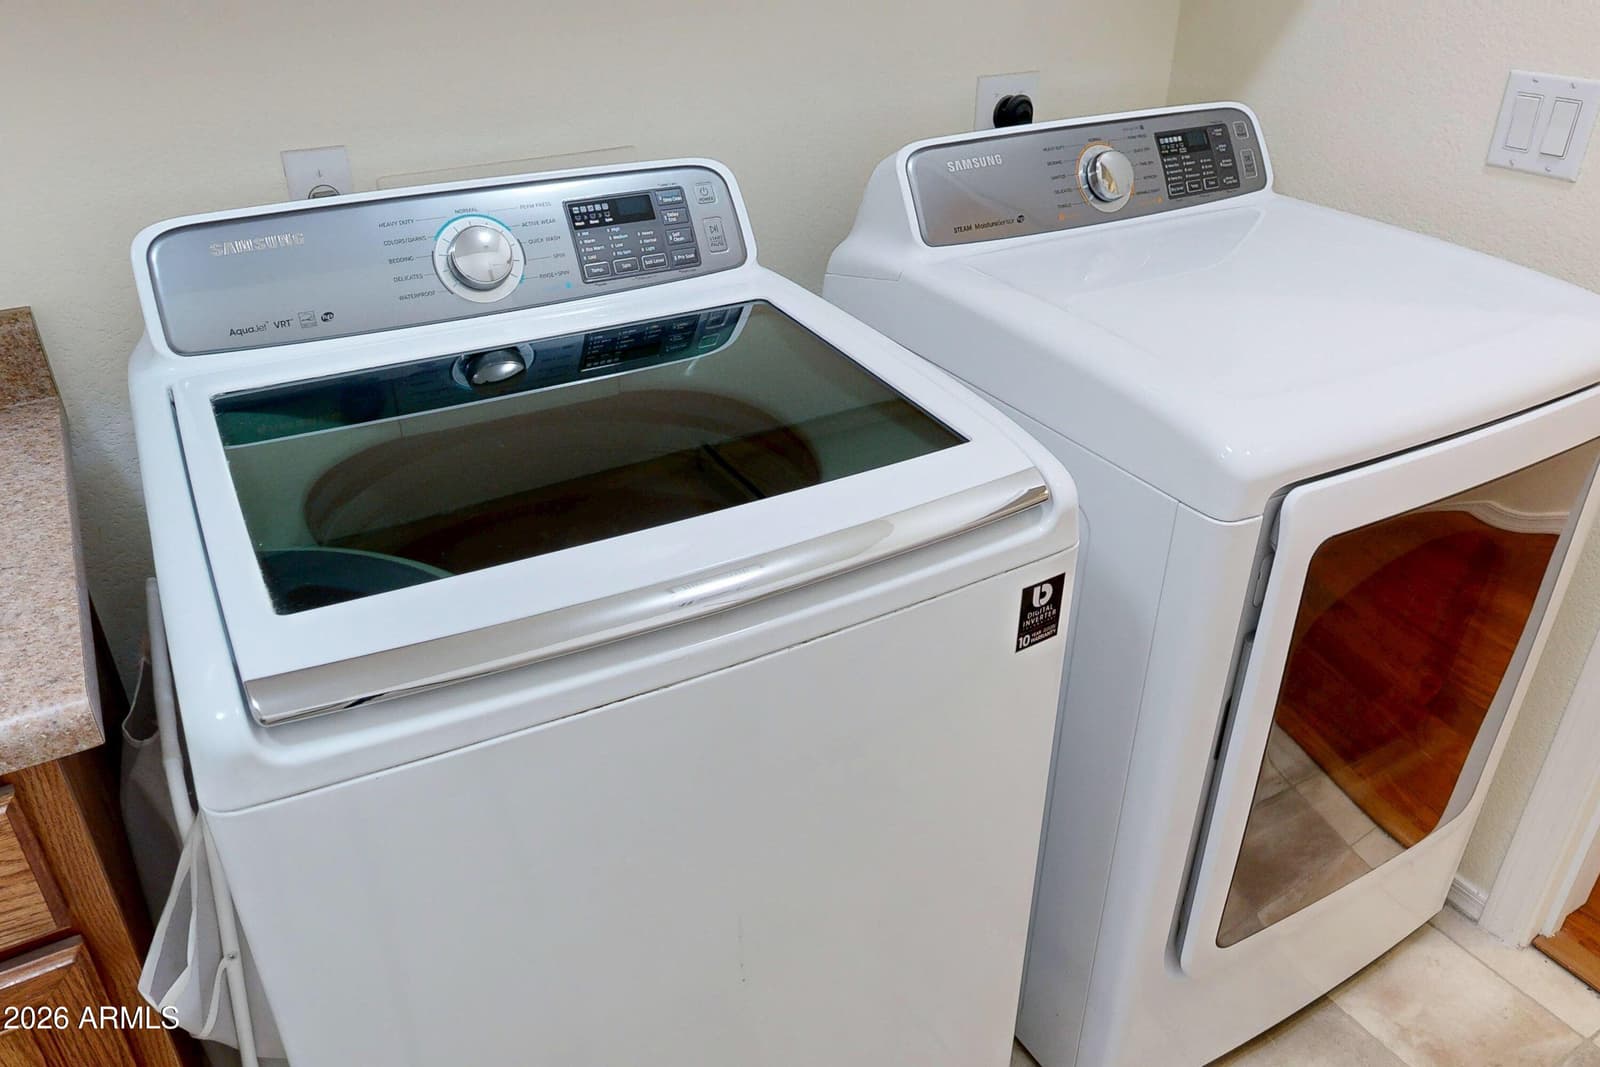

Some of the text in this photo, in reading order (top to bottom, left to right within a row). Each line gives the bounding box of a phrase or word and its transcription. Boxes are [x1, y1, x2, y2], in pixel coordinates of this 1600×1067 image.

[947, 154, 1002, 172] SAMSUNG
[379, 220, 398, 228] HEAVY
[953, 224, 972, 234] STEAM
[209, 232, 305, 256] SAMSUNG
[1023, 608, 1057, 628] INVERTER
[1027, 603, 1053, 620] DIGITAL
[1018, 634, 1031, 649] 10
